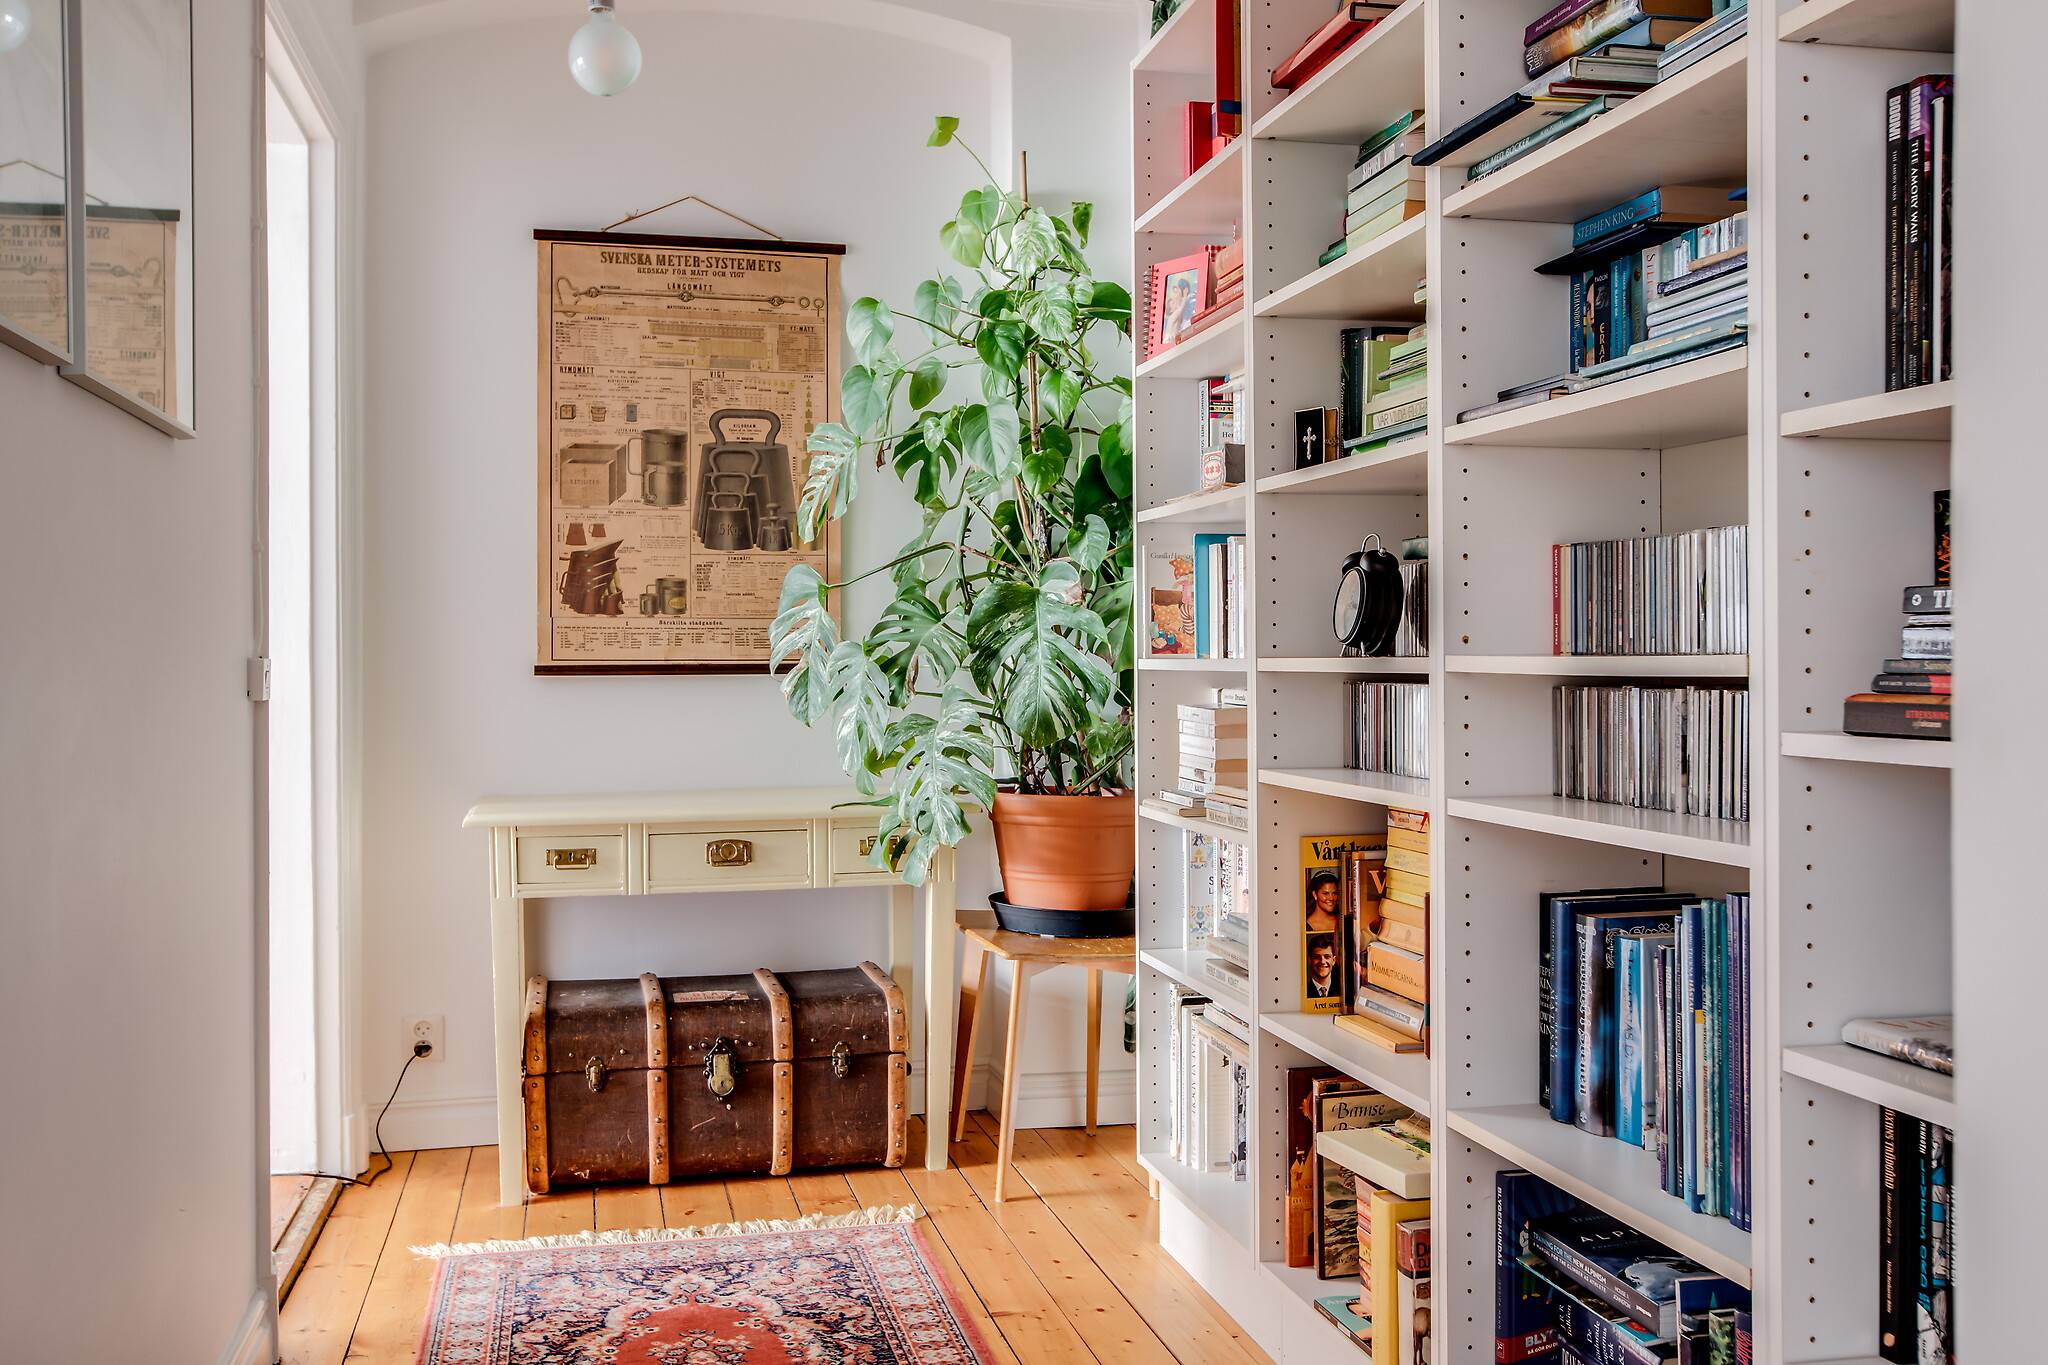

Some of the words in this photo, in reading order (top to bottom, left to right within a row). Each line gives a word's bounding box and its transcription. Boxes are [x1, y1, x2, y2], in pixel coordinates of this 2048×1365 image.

[1911, 139, 1919, 164] THE
[1911, 167, 1919, 208] AMORY
[1576, 216, 1611, 241] STEPHEN
[1611, 207, 1634, 228] KING
[1911, 211, 1919, 243] WARS
[600, 251, 652, 266] SVENSKA
[656, 254, 782, 273] METER-SYSTEMETS
[637, 267, 669, 275] REDSKAP
[1332, 1102, 1386, 1119] Bamse
[1884, 1141, 1896, 1190] TRÄDGÅRD
[1533, 1231, 1553, 1251] TRAINING
[1553, 1243, 1563, 1256] FOR
[1572, 1256, 1586, 1271] NEW
[1585, 1262, 1608, 1285] ALPINISM
[1525, 1330, 1556, 1348] BLY
